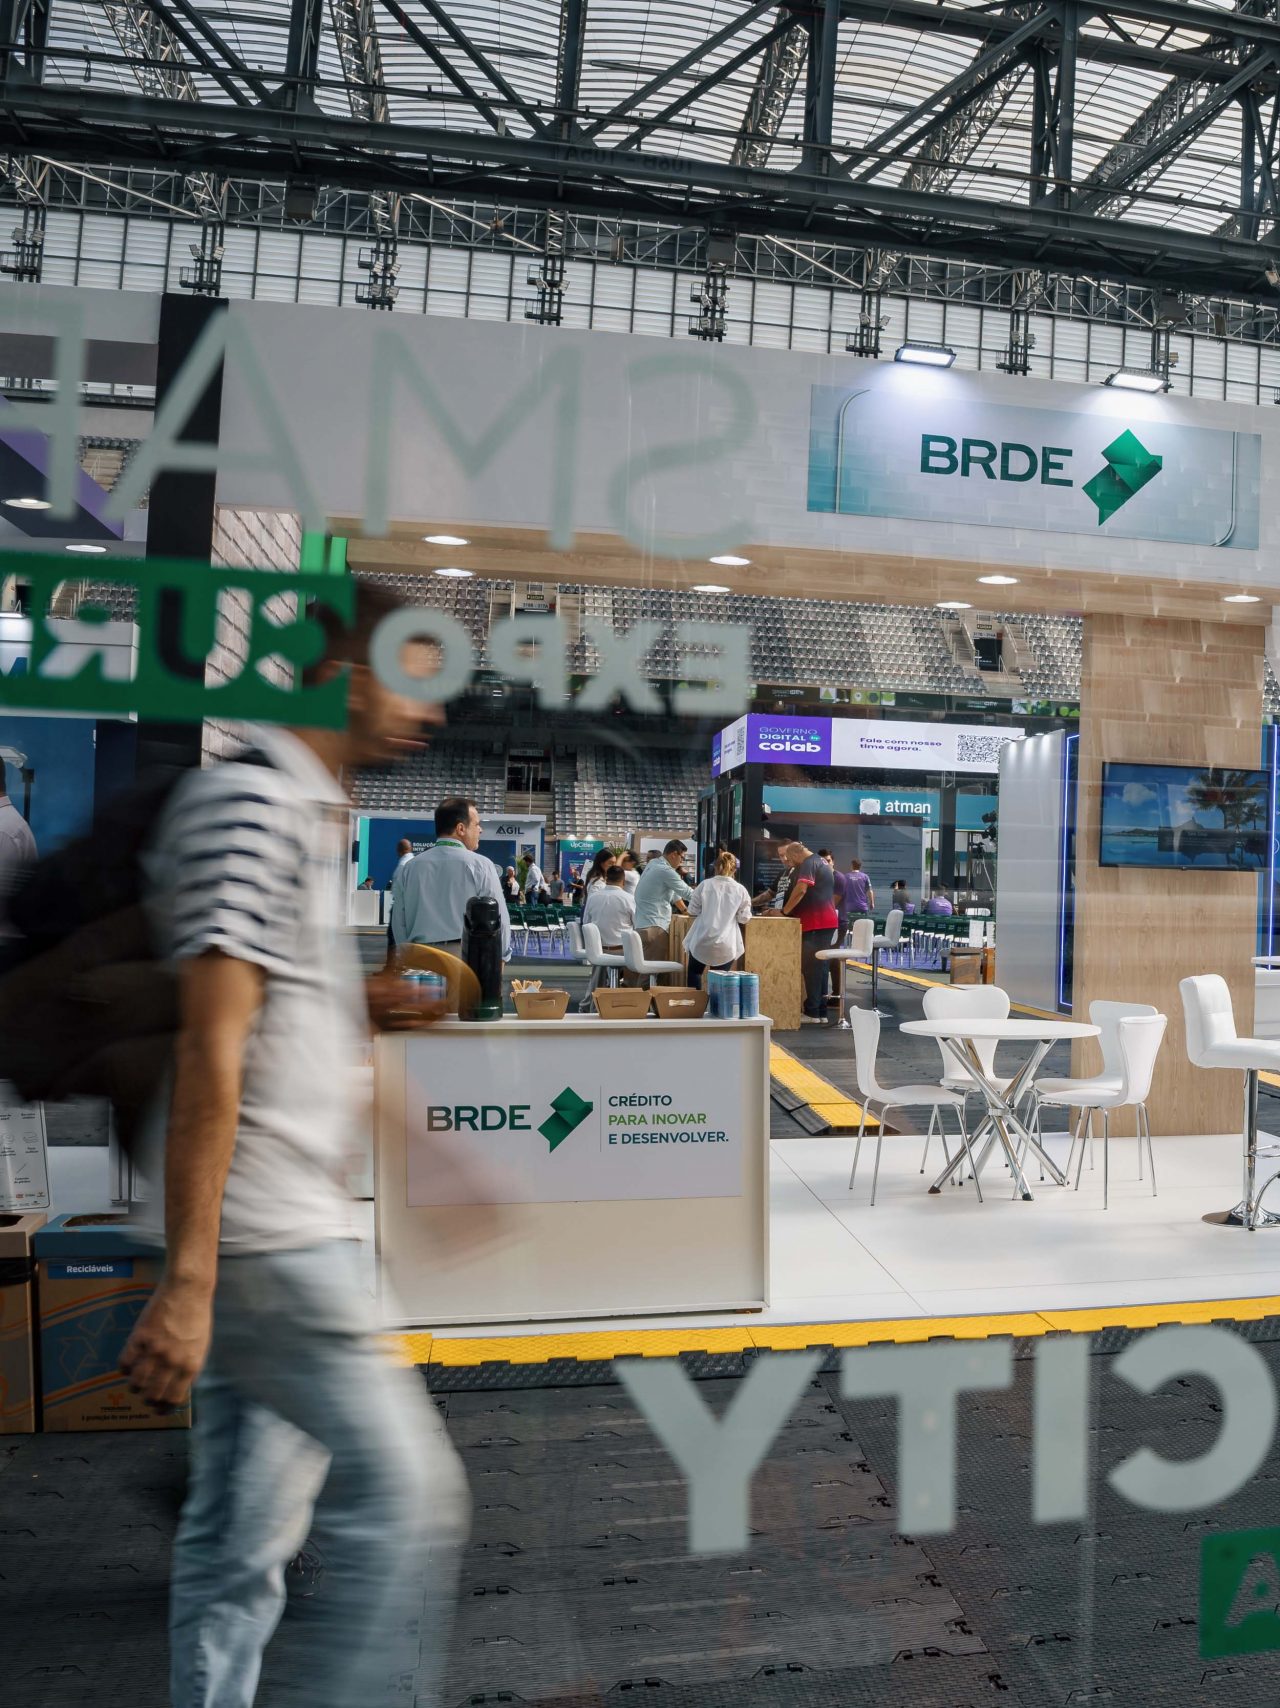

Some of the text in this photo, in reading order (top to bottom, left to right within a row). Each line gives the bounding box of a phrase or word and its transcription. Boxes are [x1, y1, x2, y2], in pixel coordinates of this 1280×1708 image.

[920, 433, 1074, 488] BRDE
[759, 727, 818, 735] GOVERNO
[758, 741, 821, 753] colab
[885, 799, 931, 815] atman
[570, 841, 594, 849] UpCities
[607, 1093, 673, 1108] CRÉDITO
[427, 1104, 532, 1132] BRDE
[607, 1113, 707, 1126] PARA INOVAR
[608, 1131, 729, 1145] E DESENVOLVER.
[66, 1264, 114, 1274] Recicláveis
